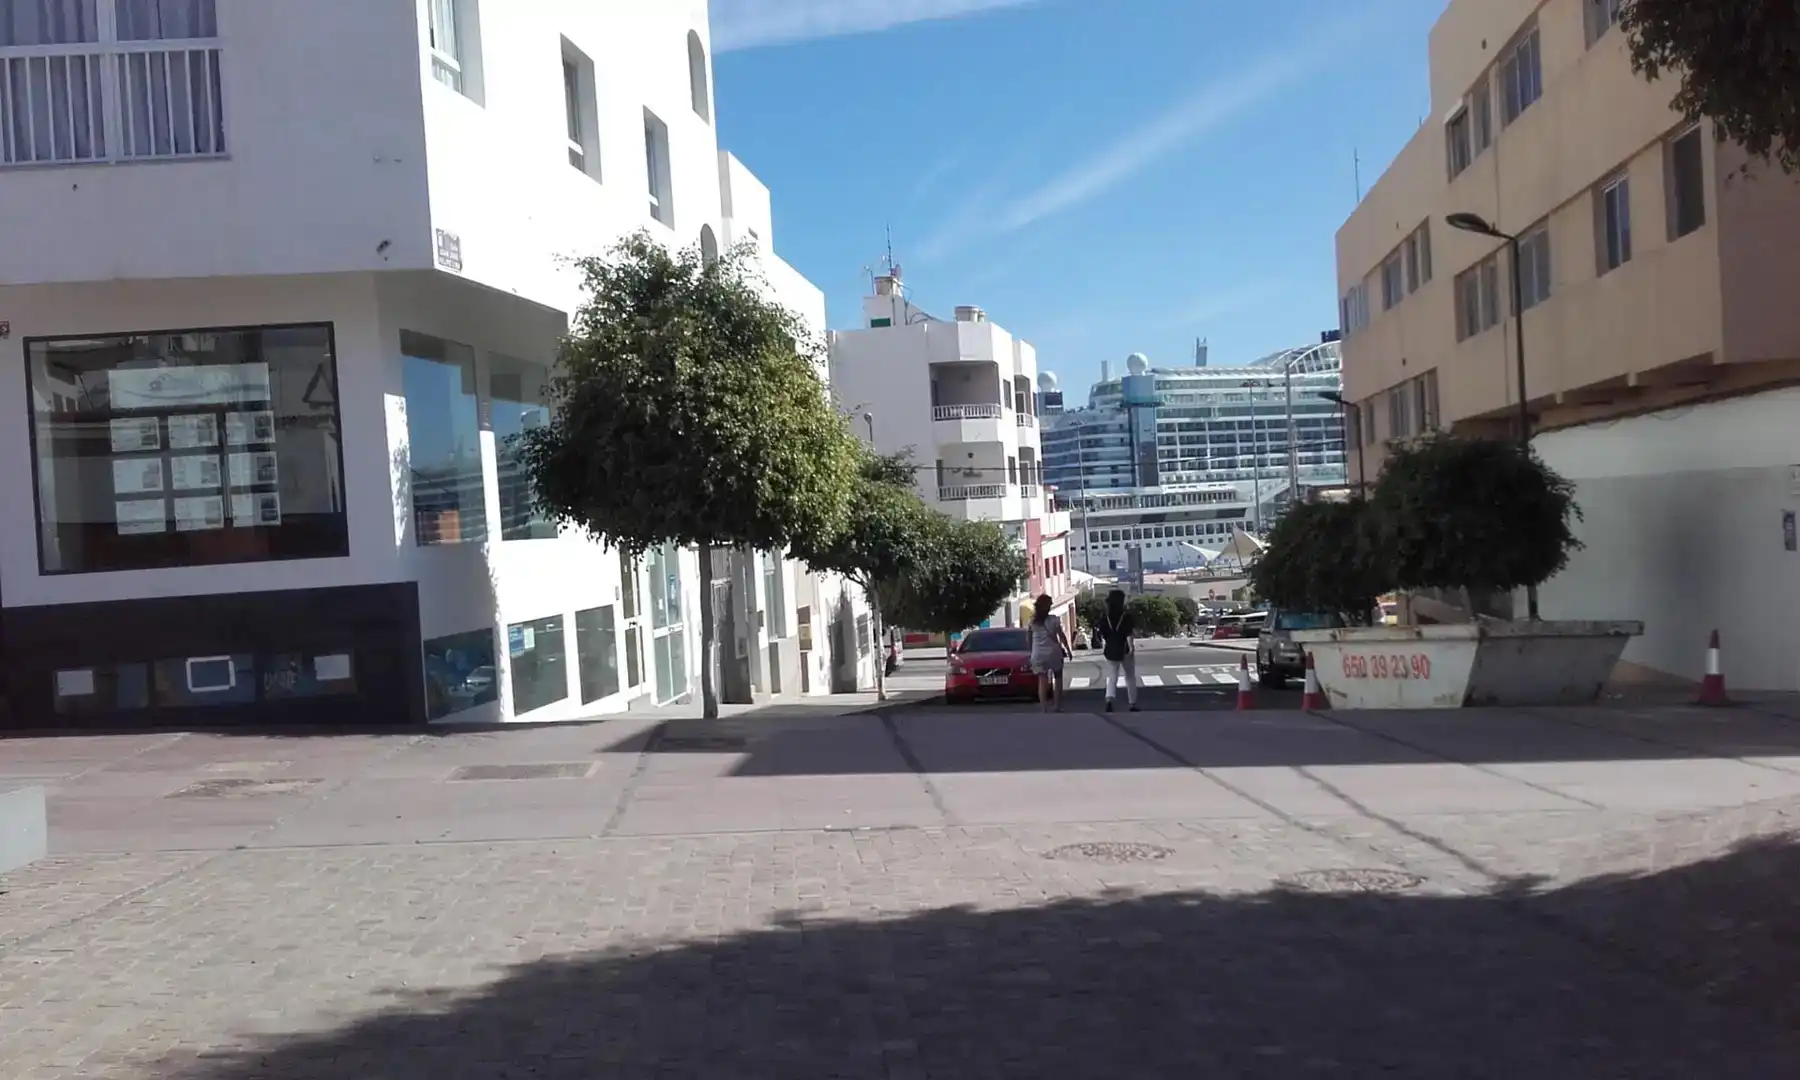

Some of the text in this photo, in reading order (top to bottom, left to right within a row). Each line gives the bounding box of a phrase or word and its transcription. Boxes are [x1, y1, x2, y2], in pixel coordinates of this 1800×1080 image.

[1342, 654, 1430, 679] 650 39 23 90
